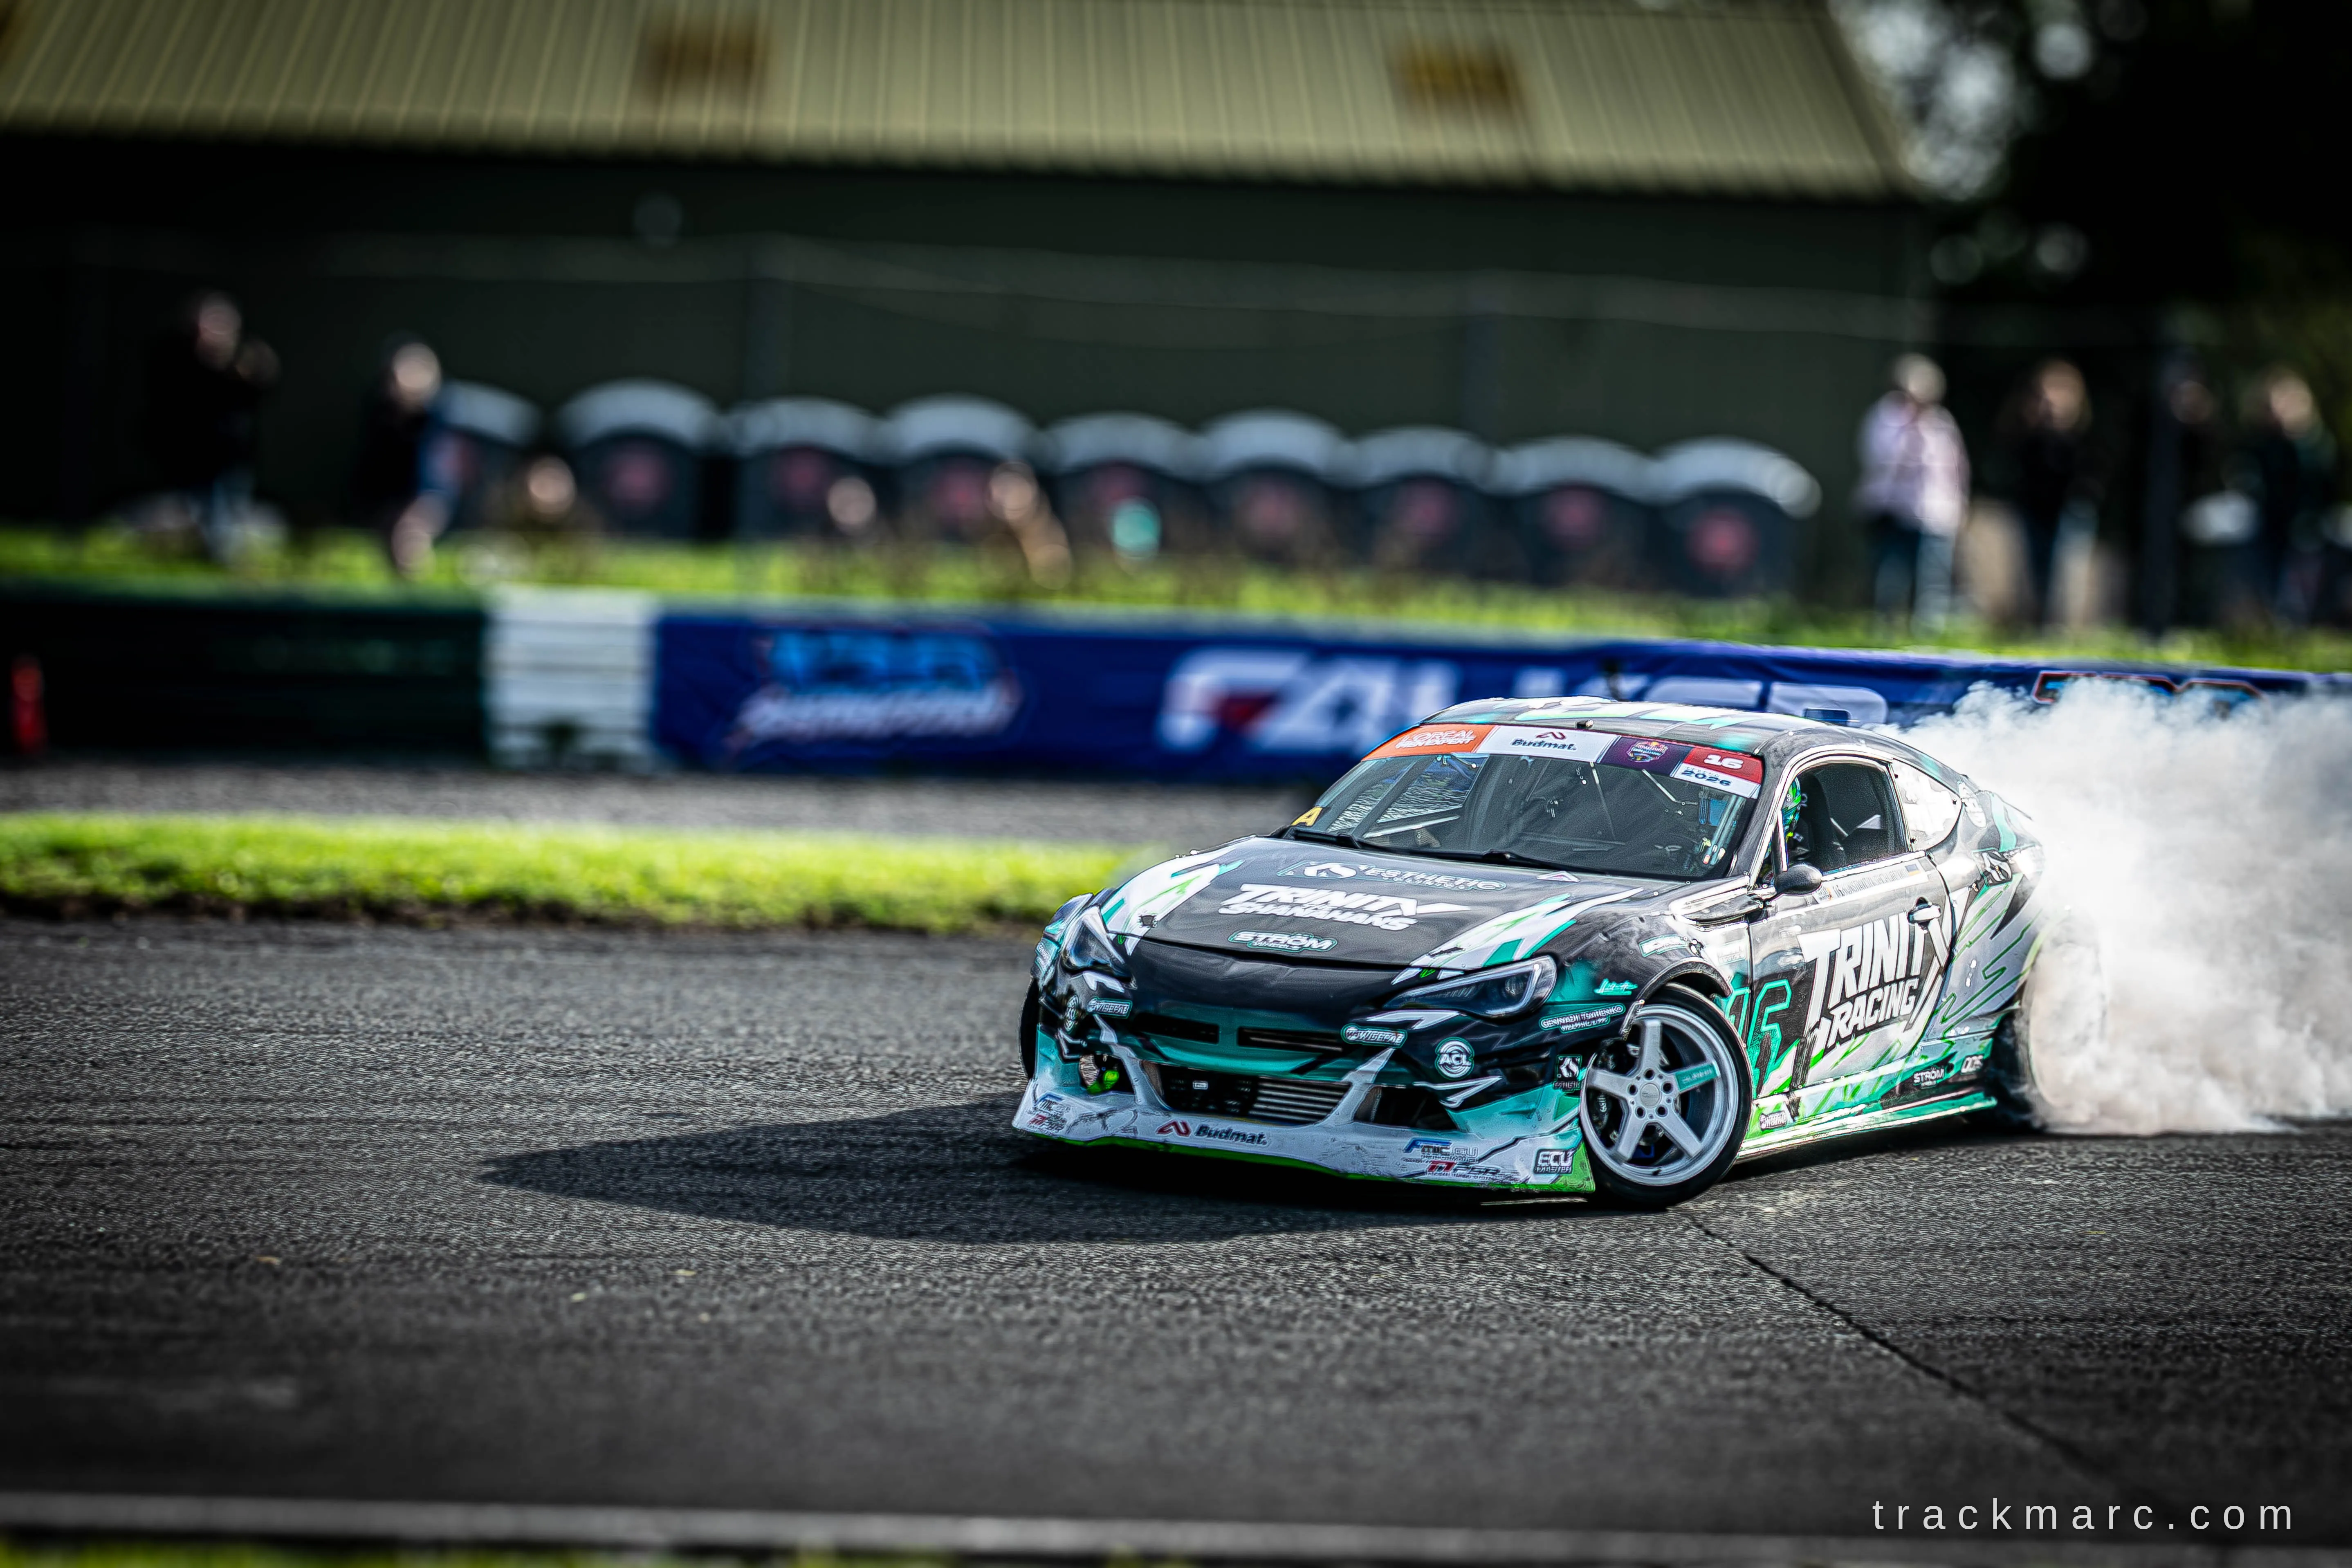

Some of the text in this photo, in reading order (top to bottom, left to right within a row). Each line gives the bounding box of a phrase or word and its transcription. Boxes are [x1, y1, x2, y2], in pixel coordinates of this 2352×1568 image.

[1395, 737, 1475, 749] MEN EXPERT
[1703, 754, 1744, 769] 16
[1681, 770, 1731, 786] 2026
[1827, 978, 1919, 1048] RACING
[1439, 1054, 1472, 1066] ACL
[1538, 1151, 1573, 1166] ECU
